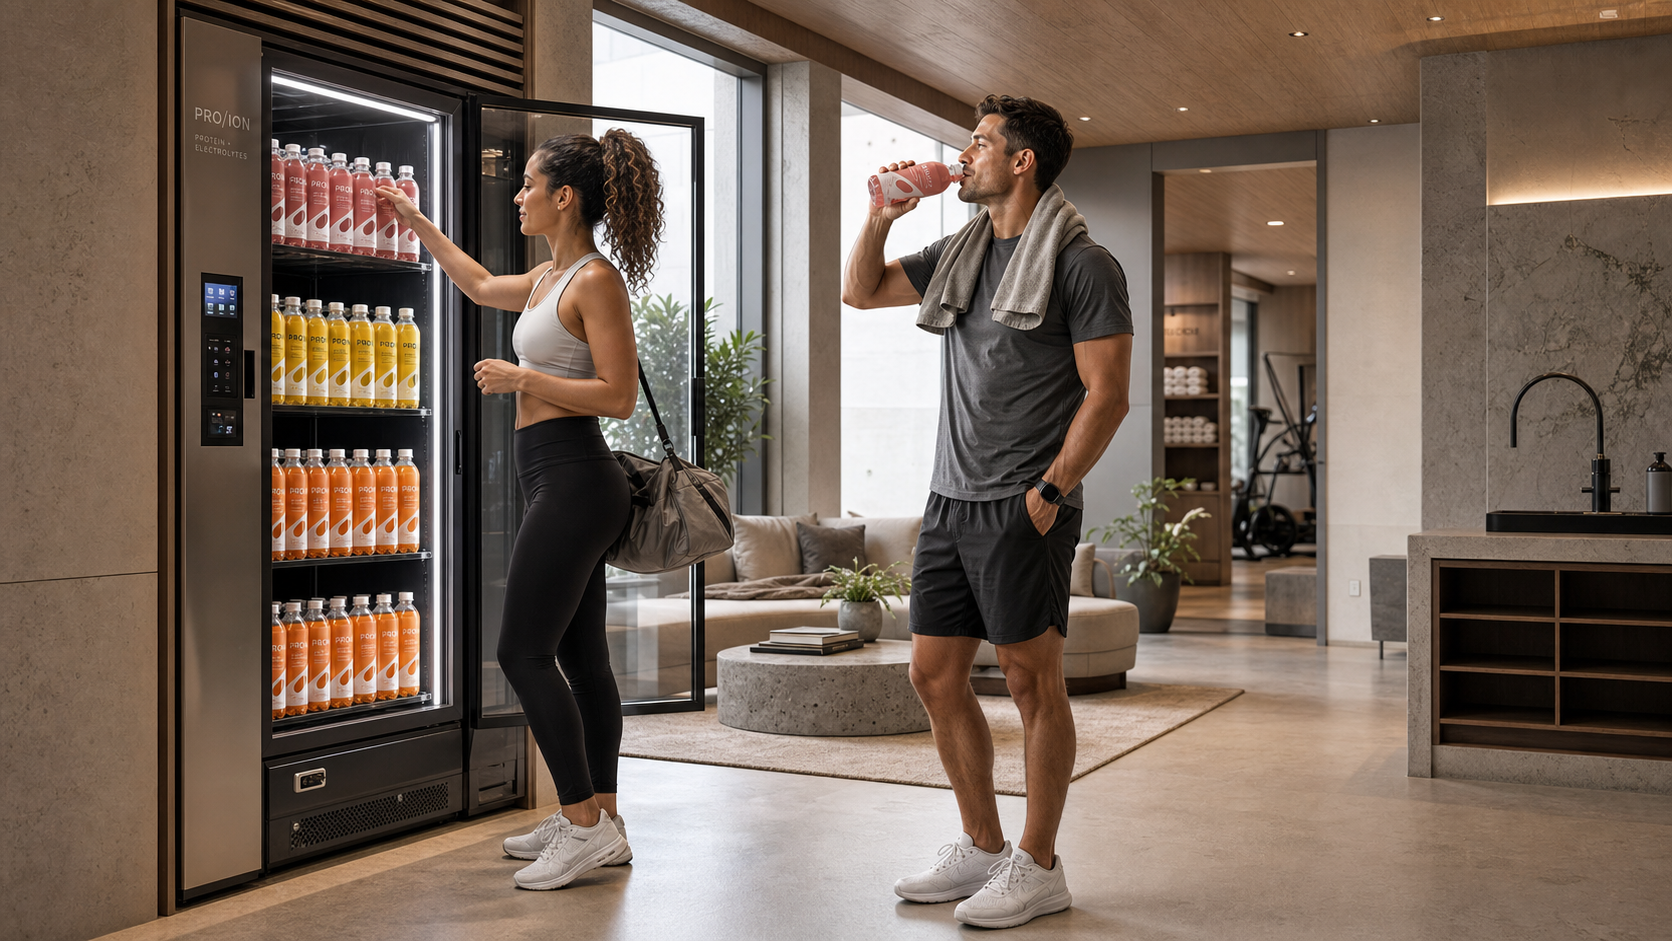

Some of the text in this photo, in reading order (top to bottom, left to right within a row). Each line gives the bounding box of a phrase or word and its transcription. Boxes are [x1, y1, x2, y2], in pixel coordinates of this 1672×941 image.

[195, 107, 250, 131] PRO/ION
[195, 134, 225, 145] PROTEIN
[195, 144, 247, 160] ELECTROLYTES
